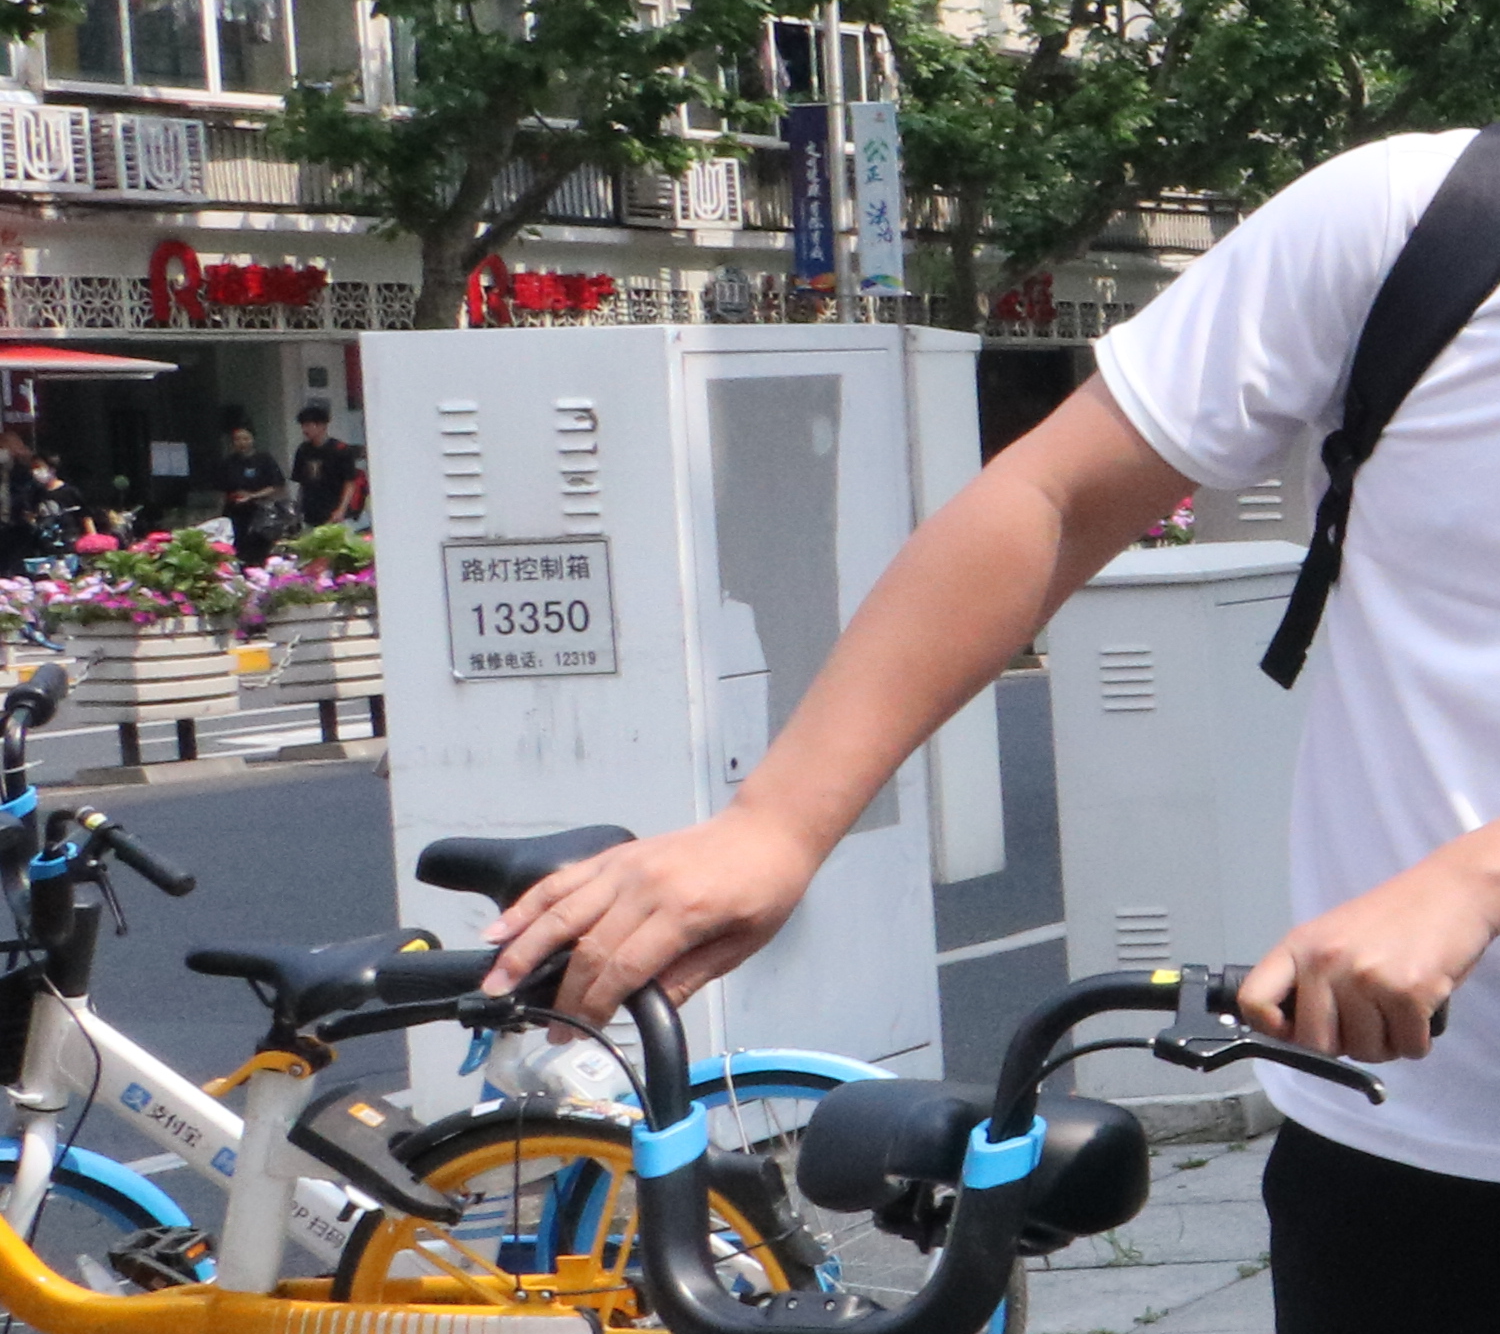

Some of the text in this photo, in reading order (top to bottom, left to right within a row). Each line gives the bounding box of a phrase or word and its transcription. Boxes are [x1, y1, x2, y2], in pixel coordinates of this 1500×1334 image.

[461, 555, 590, 583] 路灯控制箱
[471, 599, 590, 636] 13350
[555, 651, 597, 668] 12319
